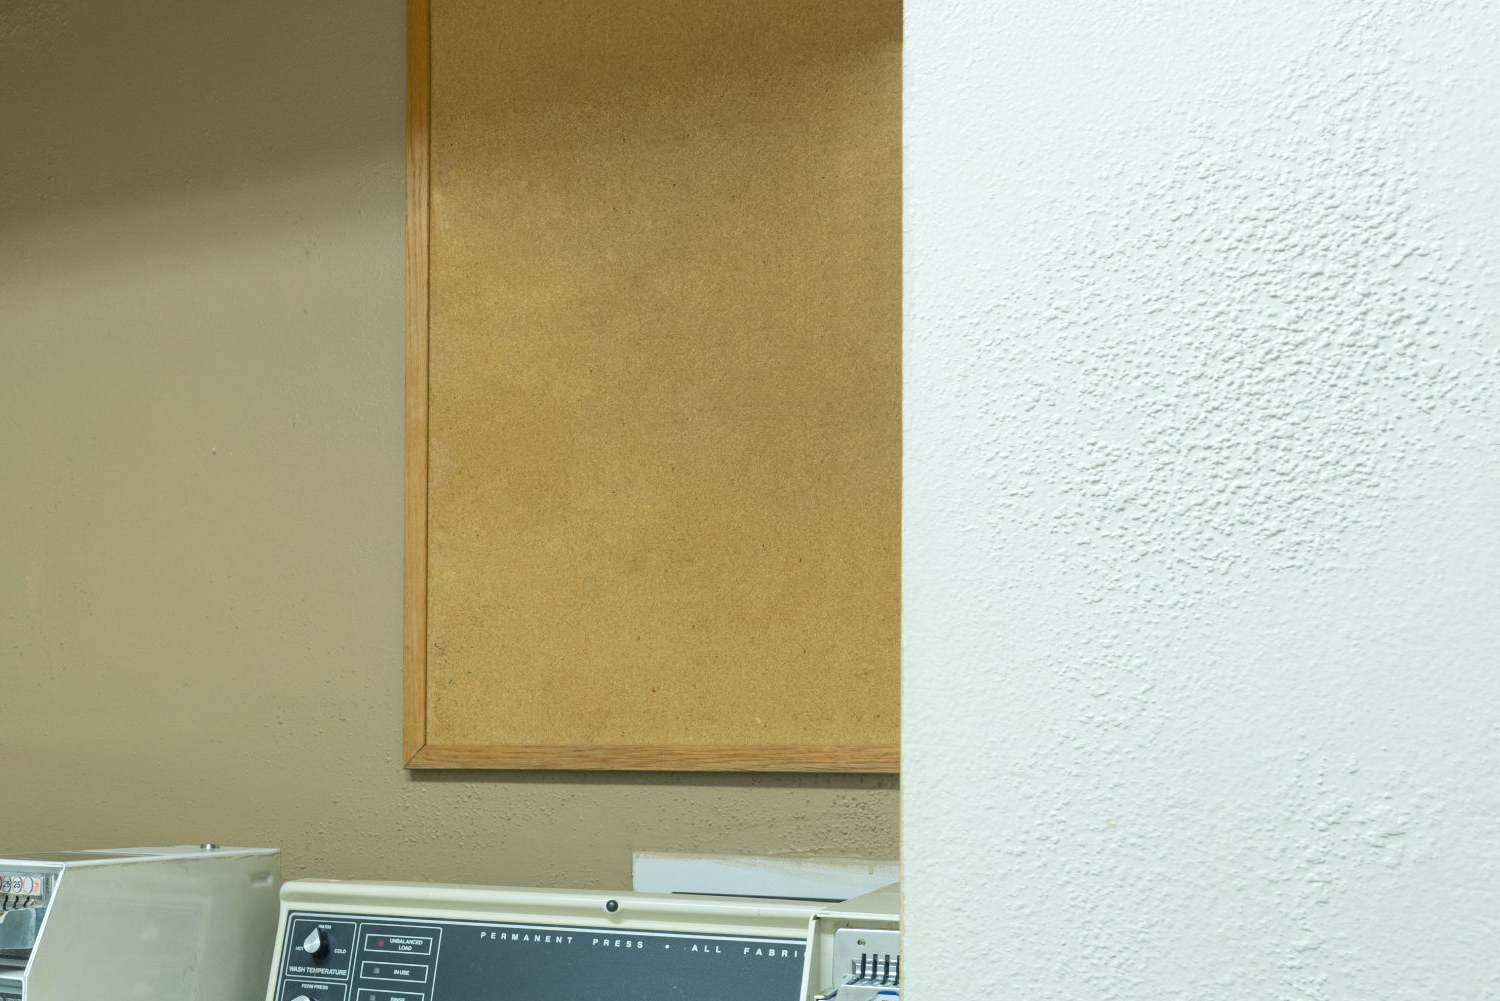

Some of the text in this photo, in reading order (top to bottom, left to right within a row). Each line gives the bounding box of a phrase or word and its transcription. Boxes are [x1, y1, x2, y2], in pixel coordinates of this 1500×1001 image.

[480, 931, 807, 957] PERMANENT PRESS ALL FABRI
[306, 967, 347, 975] TEMPERATURE
